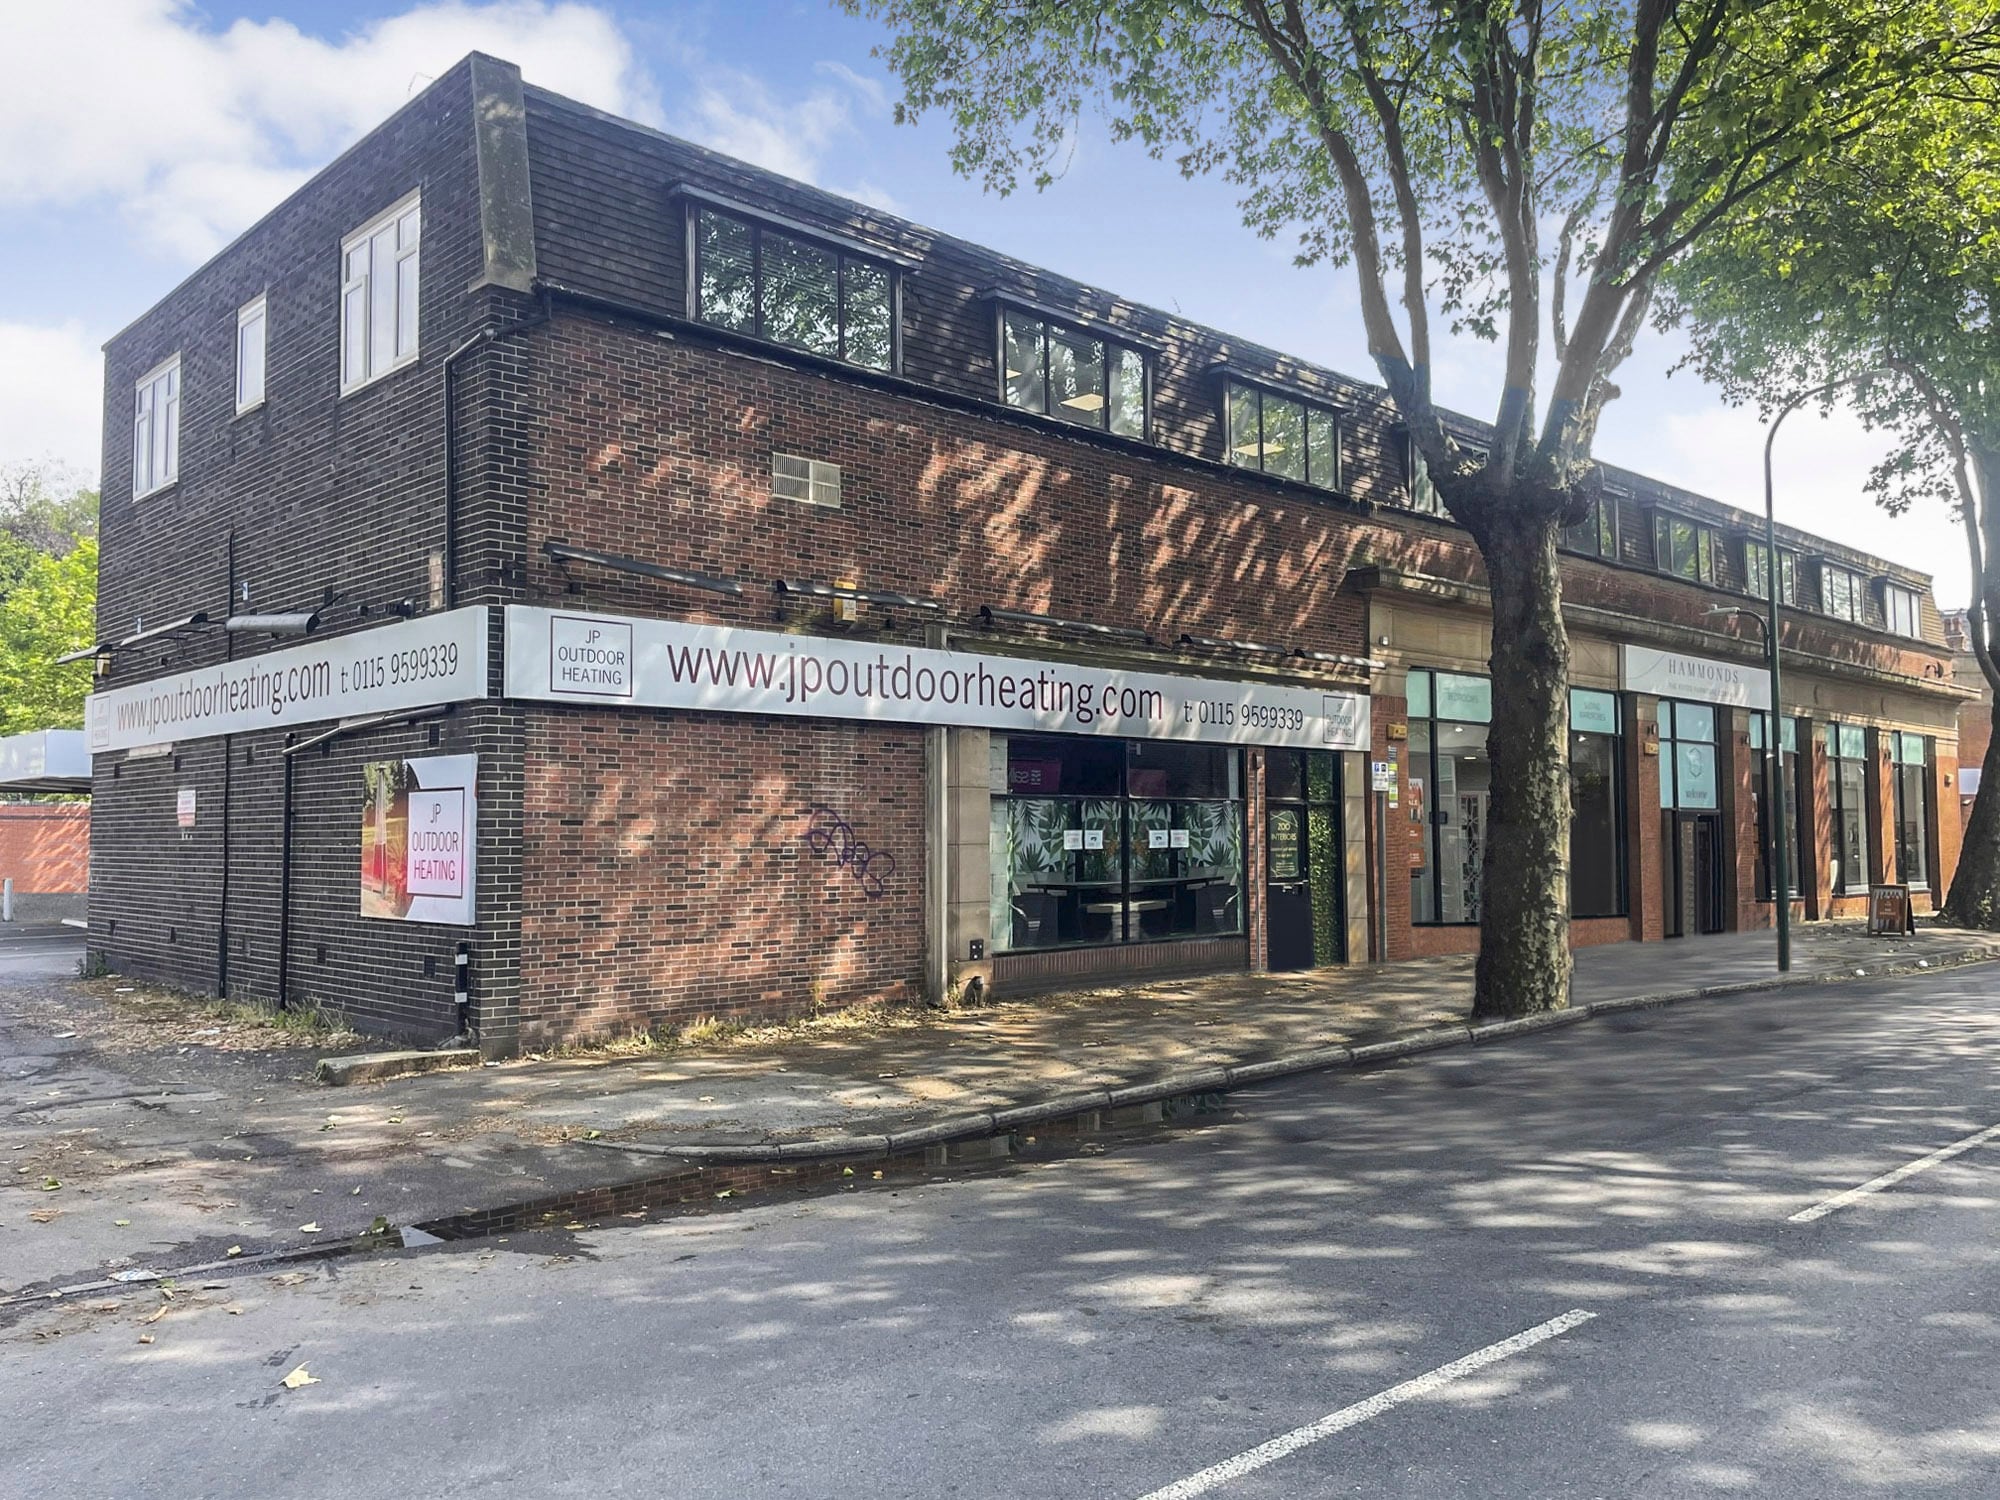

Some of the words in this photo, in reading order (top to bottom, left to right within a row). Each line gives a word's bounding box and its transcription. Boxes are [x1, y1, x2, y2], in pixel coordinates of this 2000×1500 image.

[585, 629, 601, 645] JP
[557, 646, 625, 667] OUTDOOR
[561, 666, 622, 686] HEATING
[1668, 658, 1739, 683] HAMMONDS
[117, 660, 330, 735] www.jpoutdoorheating.com
[353, 656, 385, 691] 0115
[390, 642, 458, 684] 9599339
[667, 642, 1163, 723] www.jpoutdoorheating.com
[1198, 699, 1234, 727] 0115
[1241, 703, 1304, 731] 9599339
[430, 802, 442, 823] JP
[412, 831, 459, 852] OUTDOOR
[413, 859, 455, 881] HEATING
